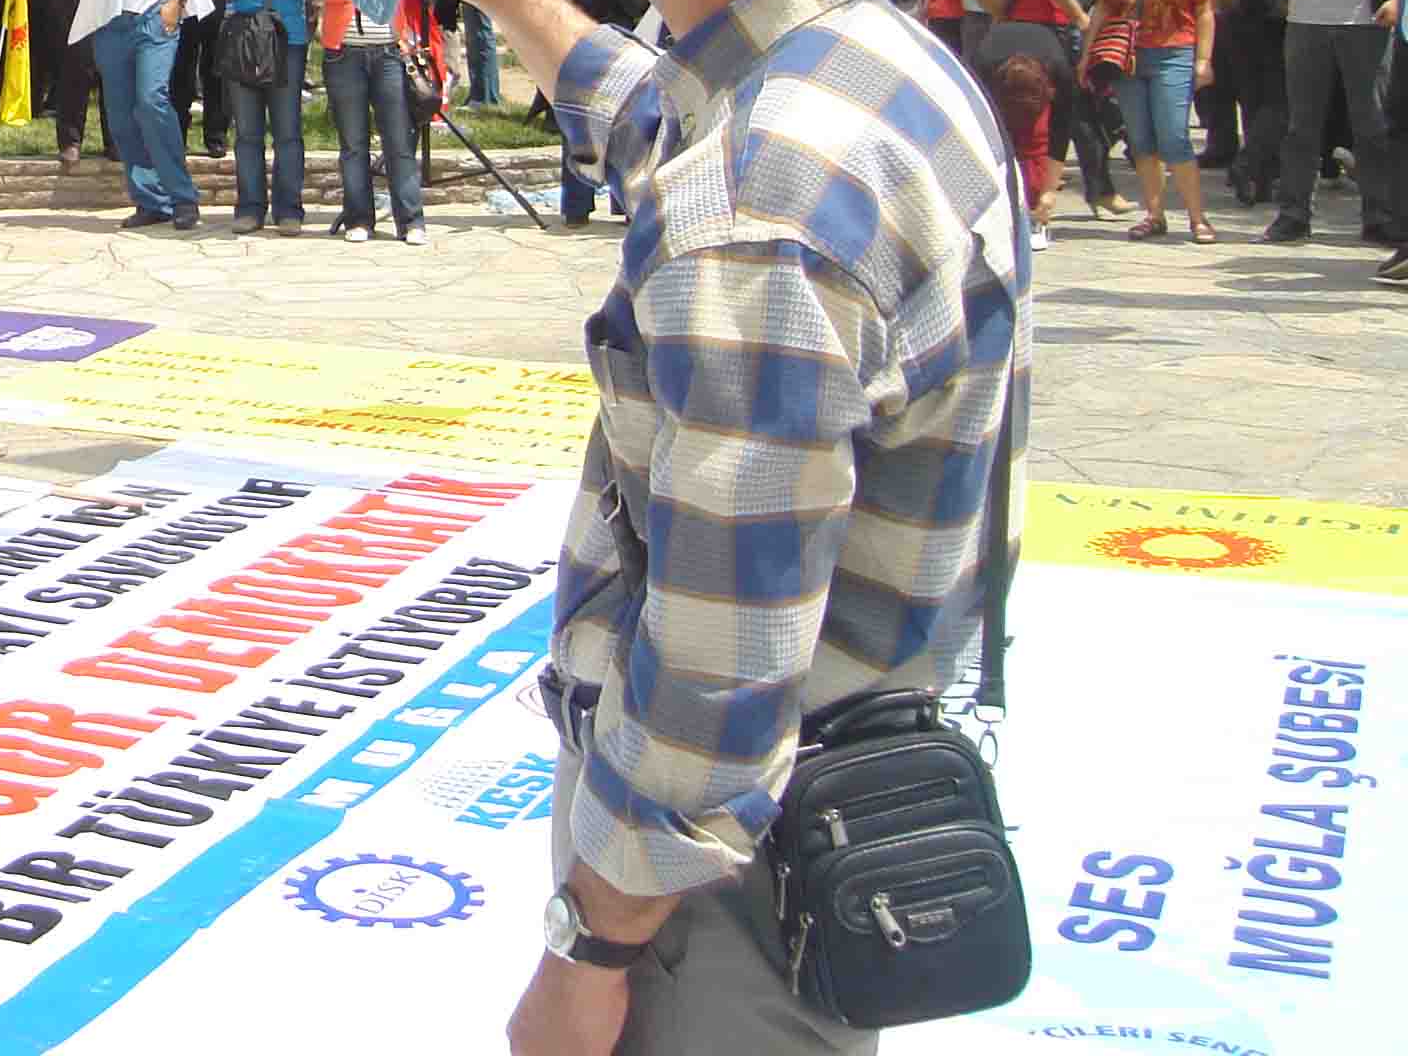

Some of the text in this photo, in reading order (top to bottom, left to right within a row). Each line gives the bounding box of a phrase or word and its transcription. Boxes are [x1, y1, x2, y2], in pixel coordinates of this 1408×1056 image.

[56, 696, 358, 849] TÜRKİYE
[454, 752, 559, 830] KESK
[1224, 654, 1377, 980] MUĞLA ŞUBESİ
[352, 870, 421, 915] DİSK
[1058, 850, 1175, 952] SES
